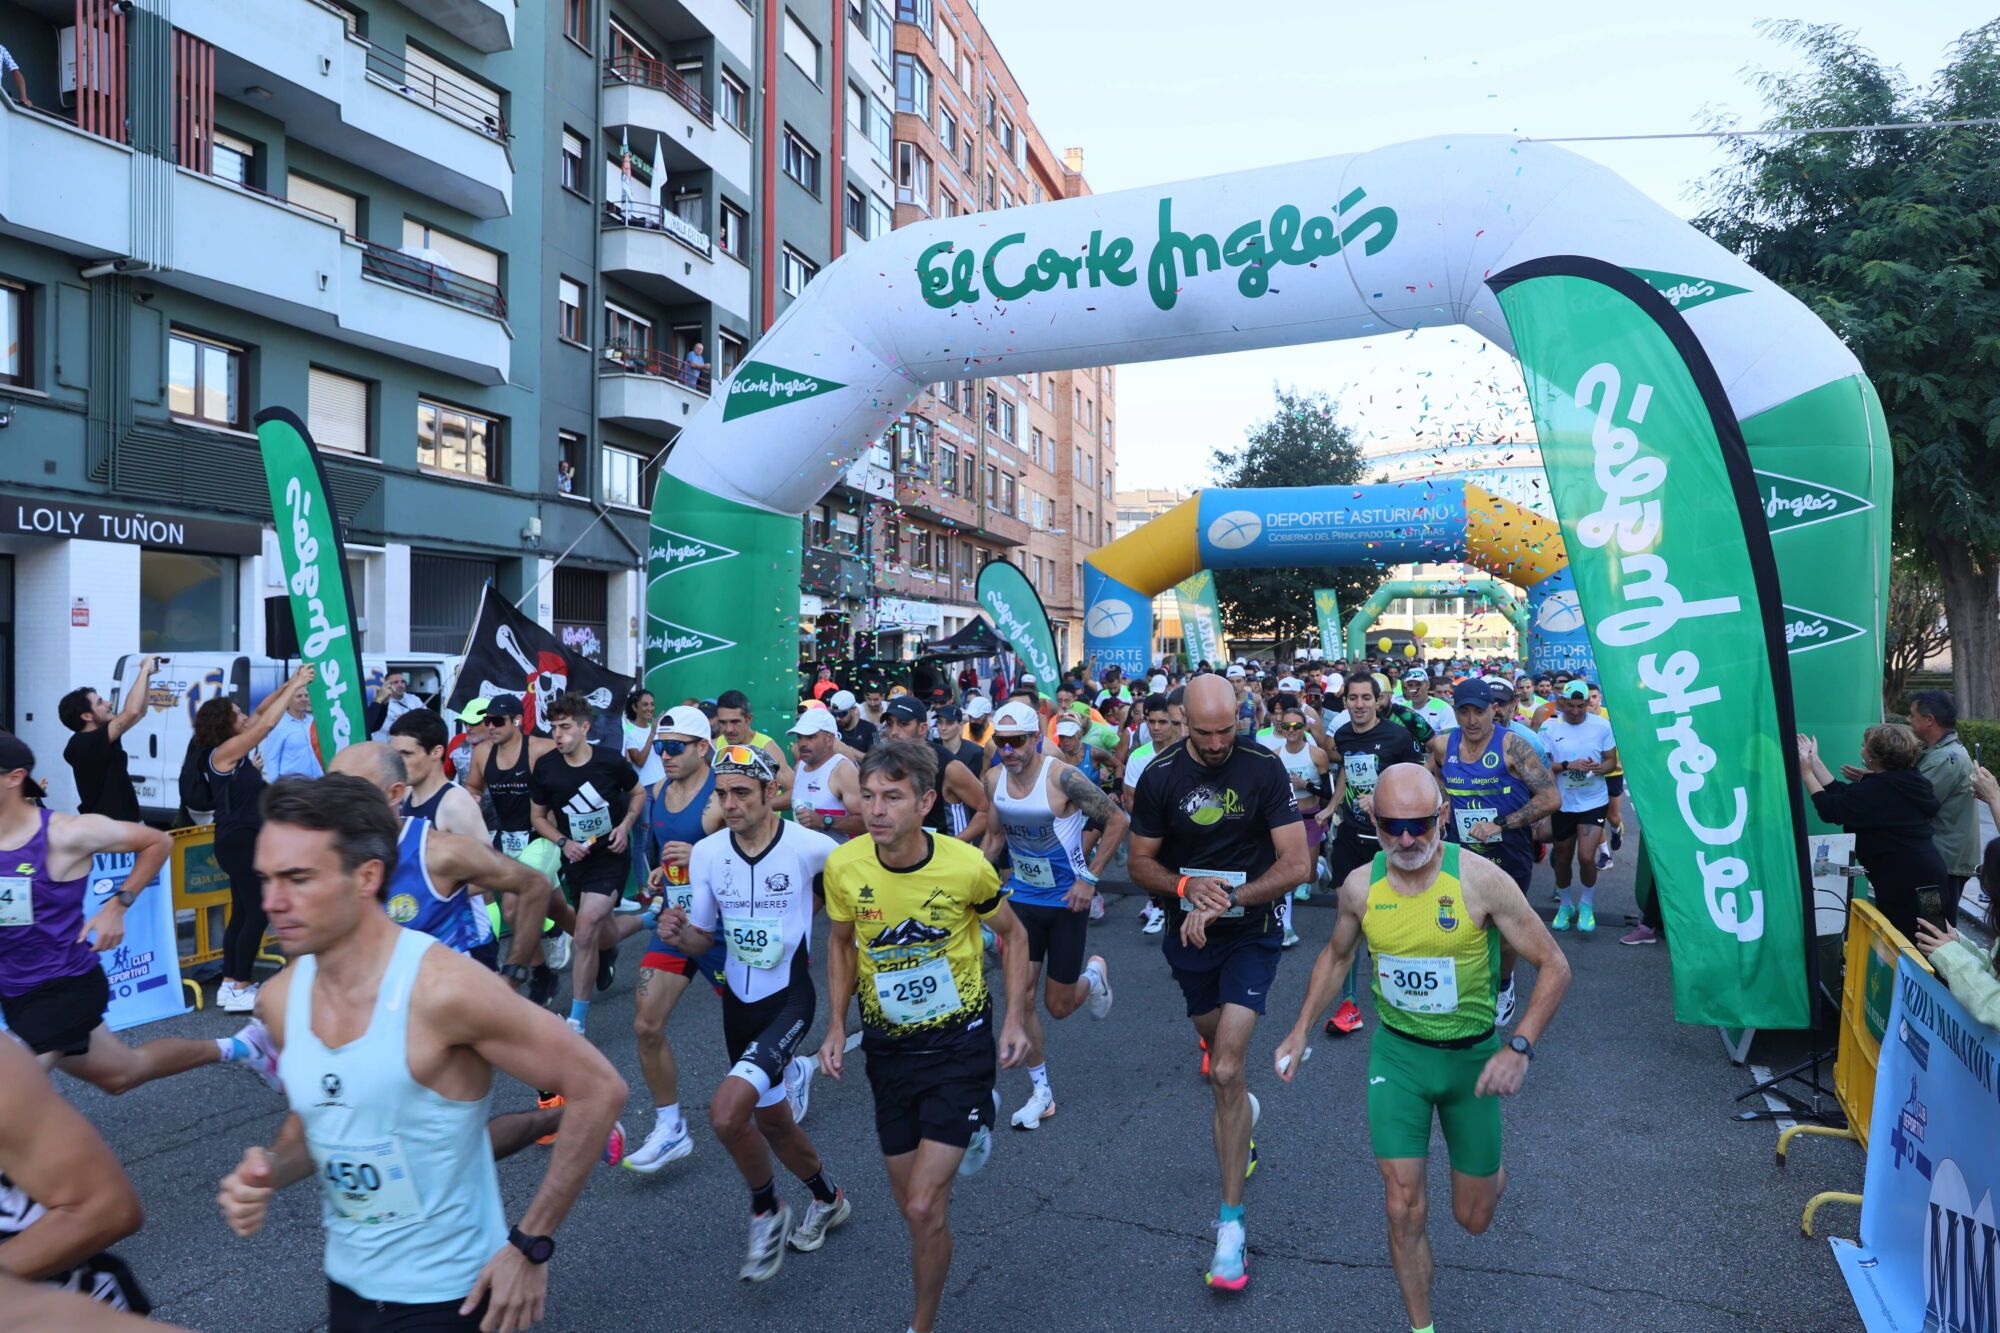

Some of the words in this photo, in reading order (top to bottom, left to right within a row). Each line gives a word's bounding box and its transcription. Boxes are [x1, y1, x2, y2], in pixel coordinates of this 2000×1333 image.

[917, 241, 980, 309] El
[983, 230, 1137, 301] Corte
[1148, 186, 1398, 311] Inglés
[1655, 280, 1716, 306] glés
[741, 378, 769, 393] Corte
[769, 372, 818, 398] Inglés
[1767, 486, 1837, 518] Inglés
[18, 506, 85, 535] LOLY
[98, 513, 184, 545] TUÑON
[1267, 510, 1345, 528] DEPORTE
[1350, 506, 1449, 525] ASTURIANO
[665, 539, 706, 563] Inglés
[662, 630, 703, 653] Inglés
[1785, 619, 1829, 644] glés
[1535, 644, 1592, 658] DEPOR
[1535, 658, 1597, 670] ASTURIAN
[1349, 761, 1368, 773] 134
[578, 816, 603, 831] 526
[754, 900, 788, 909] MIERES
[733, 928, 768, 947] 548
[132, 952, 152, 966] CLUB
[893, 975, 937, 1002] 259
[1393, 969, 1438, 990] 305
[1404, 989, 1429, 997] JESUS
[1937, 1004, 1995, 1094] MARATÓN
